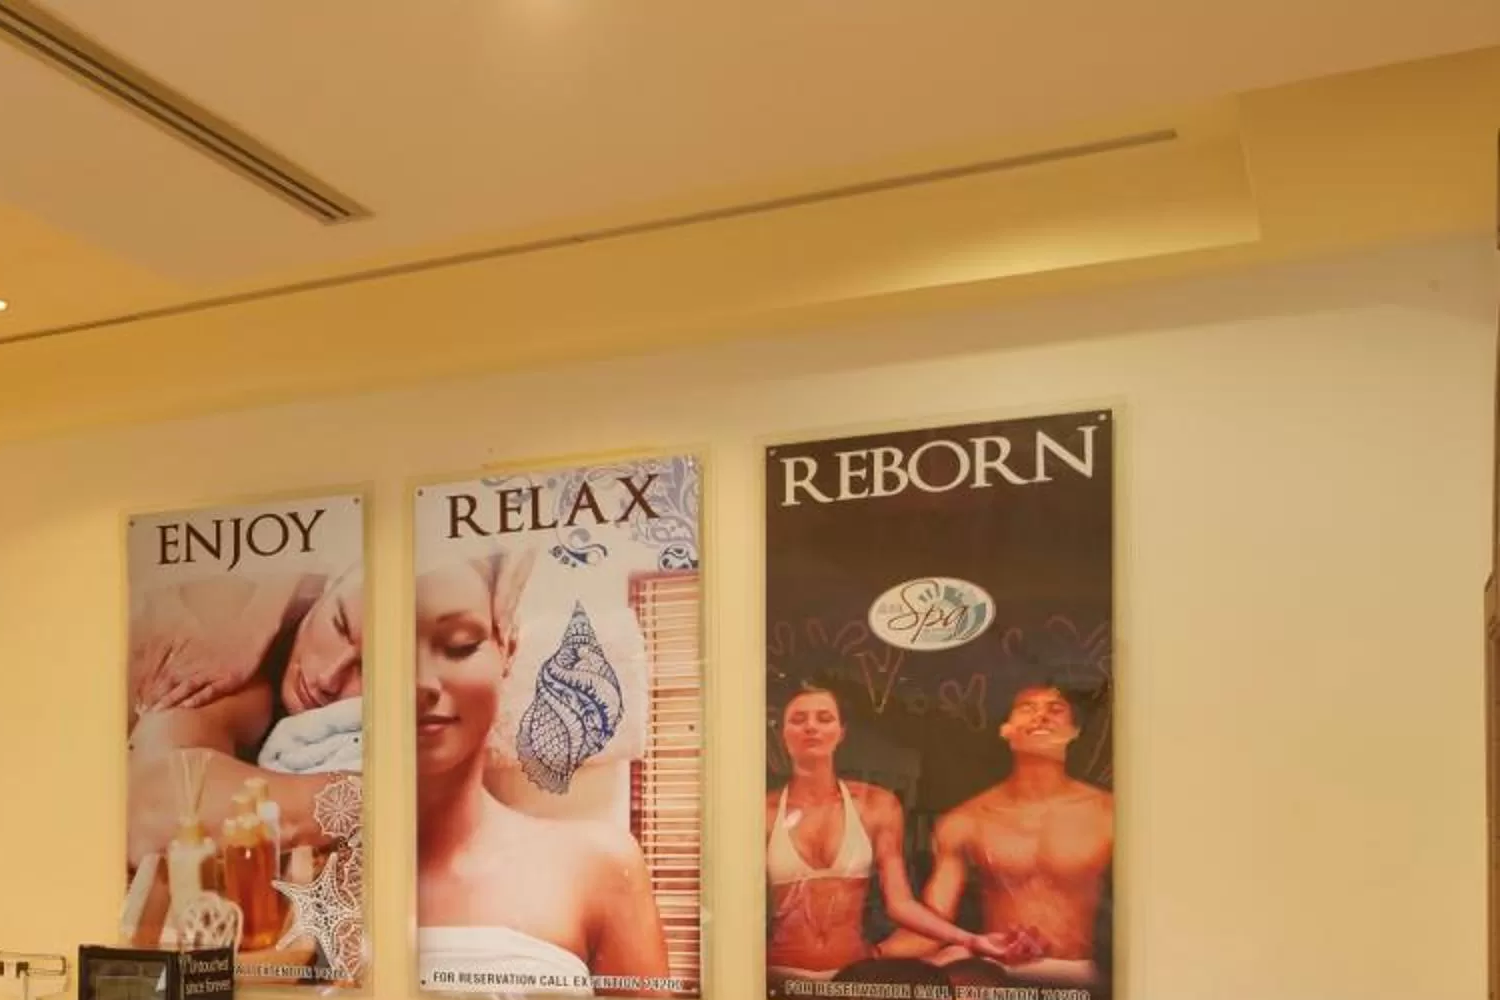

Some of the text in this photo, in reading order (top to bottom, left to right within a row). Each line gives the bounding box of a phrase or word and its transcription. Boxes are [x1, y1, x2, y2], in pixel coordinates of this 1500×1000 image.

[780, 425, 1099, 507] REBORN
[446, 472, 662, 539] RELAX
[156, 507, 326, 572] ENJOY
[887, 579, 970, 644] Spa
[433, 970, 455, 983] FOR
[458, 972, 537, 986] RESERVATION
[540, 975, 568, 987] CALL
[784, 980, 812, 995] FOR
